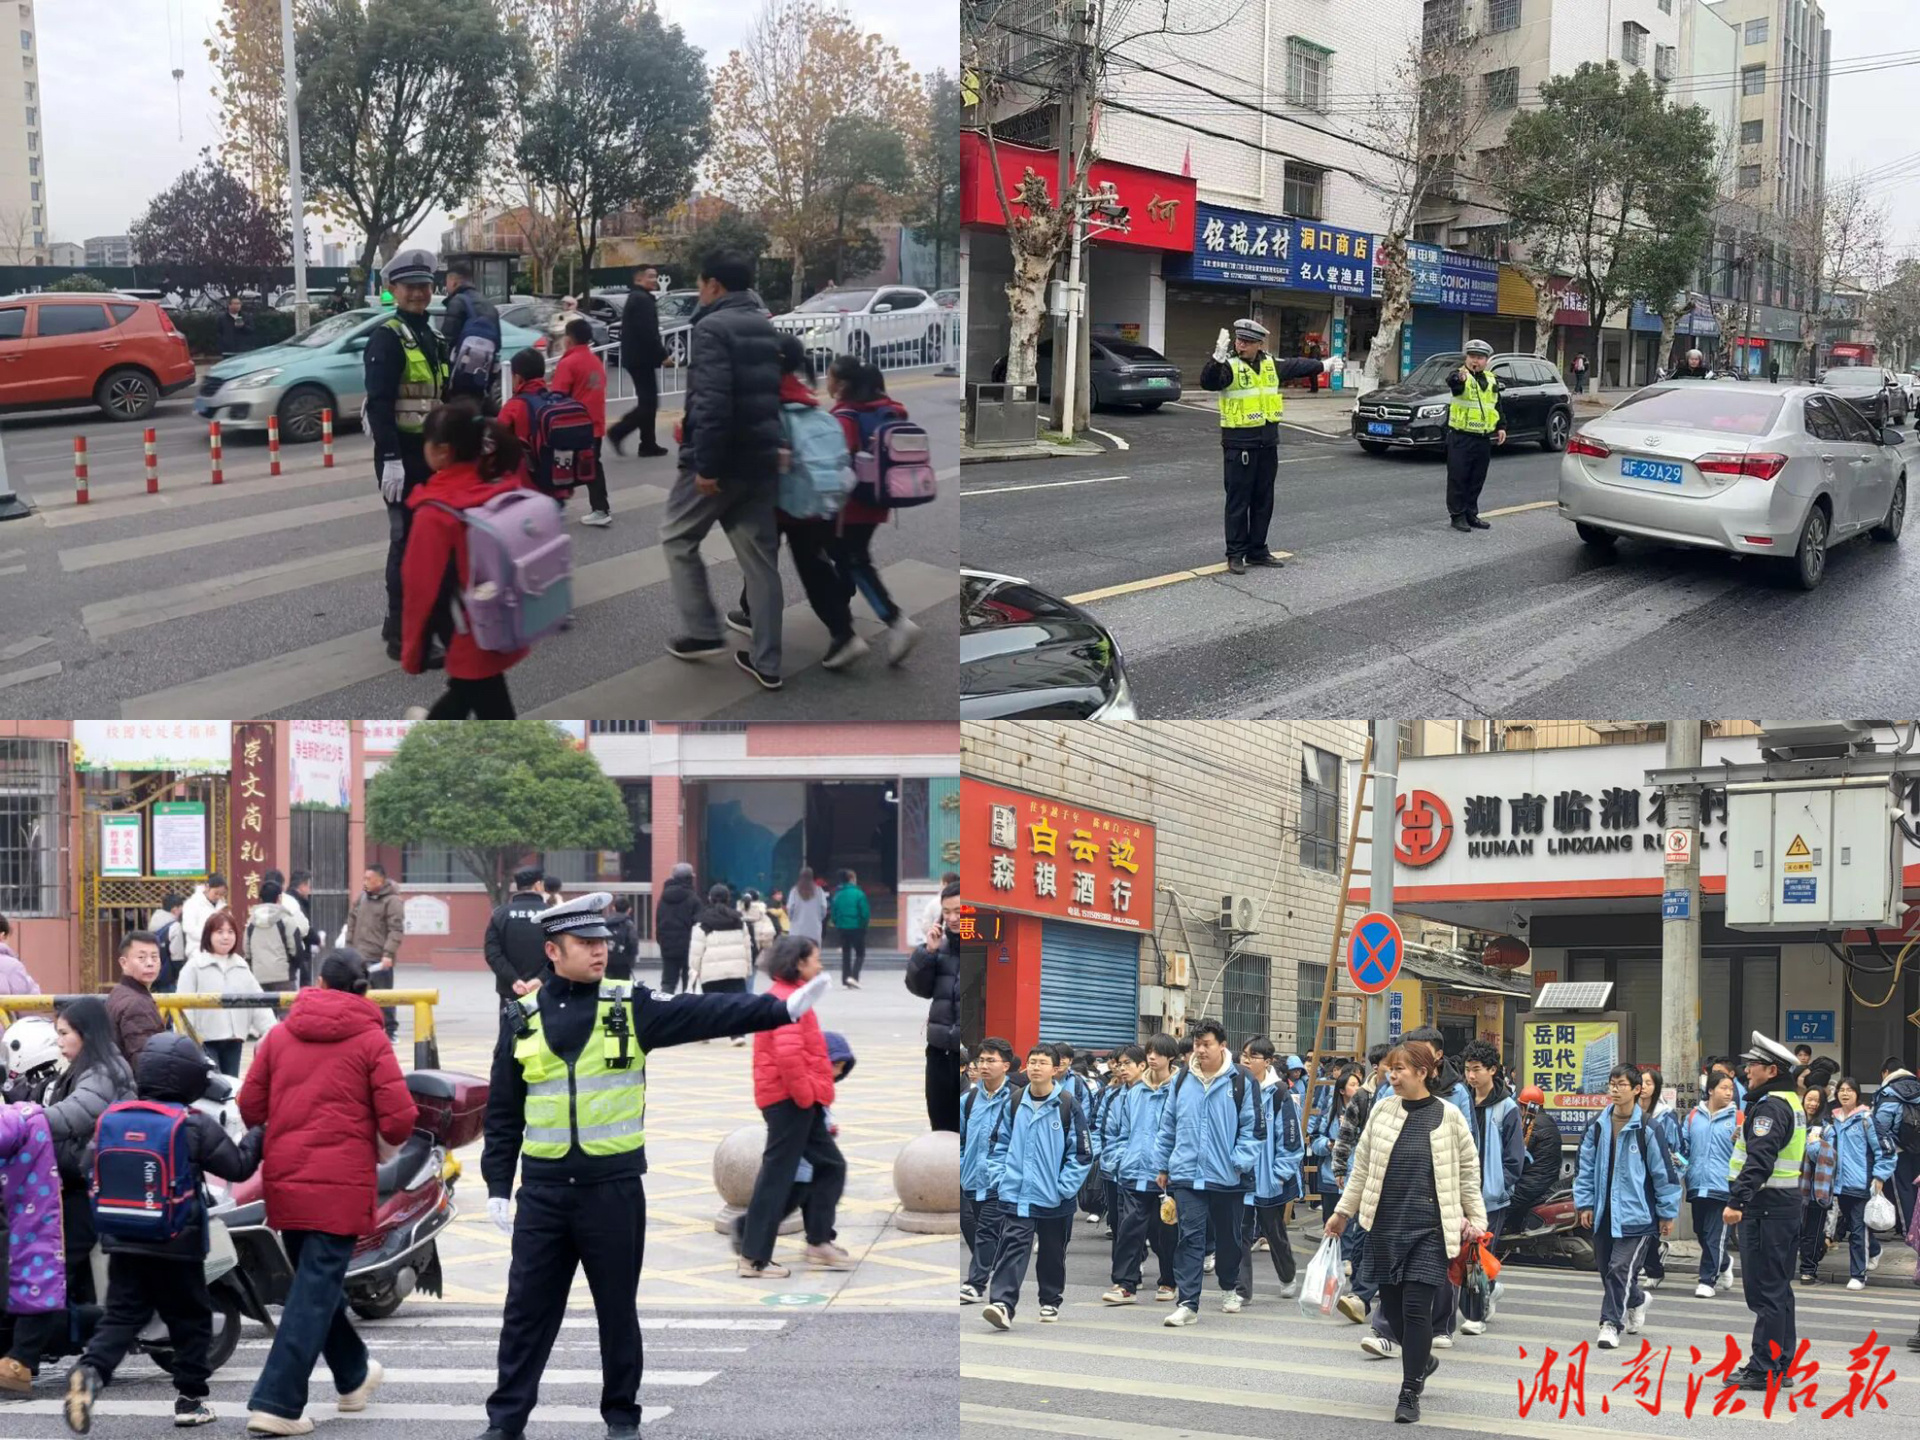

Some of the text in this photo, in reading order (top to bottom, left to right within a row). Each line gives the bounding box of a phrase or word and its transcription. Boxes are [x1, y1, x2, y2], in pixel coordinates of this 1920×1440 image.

[1202, 217, 1290, 260] 铭瑞石材
[1301, 226, 1367, 260] 洞口商店
[1301, 262, 1365, 286] 名人堂渔具
[1441, 274, 1470, 289] CONCH
[240, 737, 266, 915] 崇文尚礼育
[1030, 817, 1140, 874] 白云边
[1468, 839, 1534, 859] HUNAN
[1547, 834, 1633, 856] LINXIANG
[992, 853, 1133, 912] 森祺酒行
[1533, 1025, 1575, 1045] 岳阳
[1801, 1022, 1819, 1034] 67
[1533, 1048, 1576, 1069] 现代
[1534, 1072, 1577, 1093] 医院
[1561, 1111, 1585, 1122] 8339
